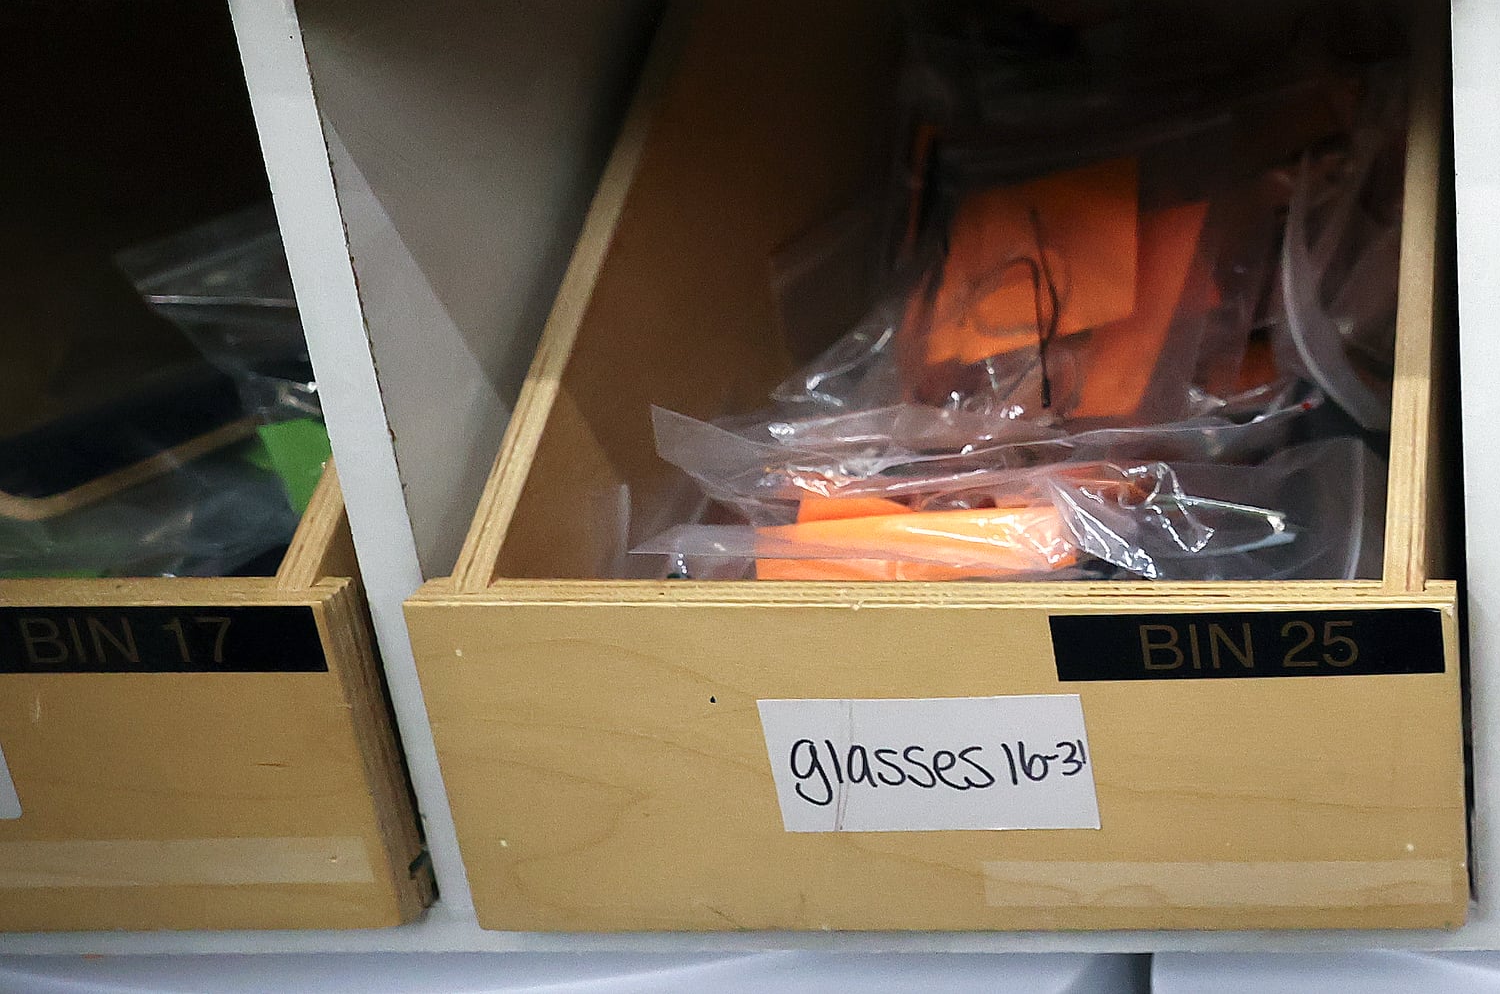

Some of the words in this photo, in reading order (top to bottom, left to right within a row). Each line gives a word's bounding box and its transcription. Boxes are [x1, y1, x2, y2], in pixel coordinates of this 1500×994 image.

[19, 615, 142, 664] BIN
[163, 616, 232, 664] 17
[1139, 621, 1254, 672] BIN
[1280, 620, 1359, 669] 25
[789, 738, 996, 806] glasses
